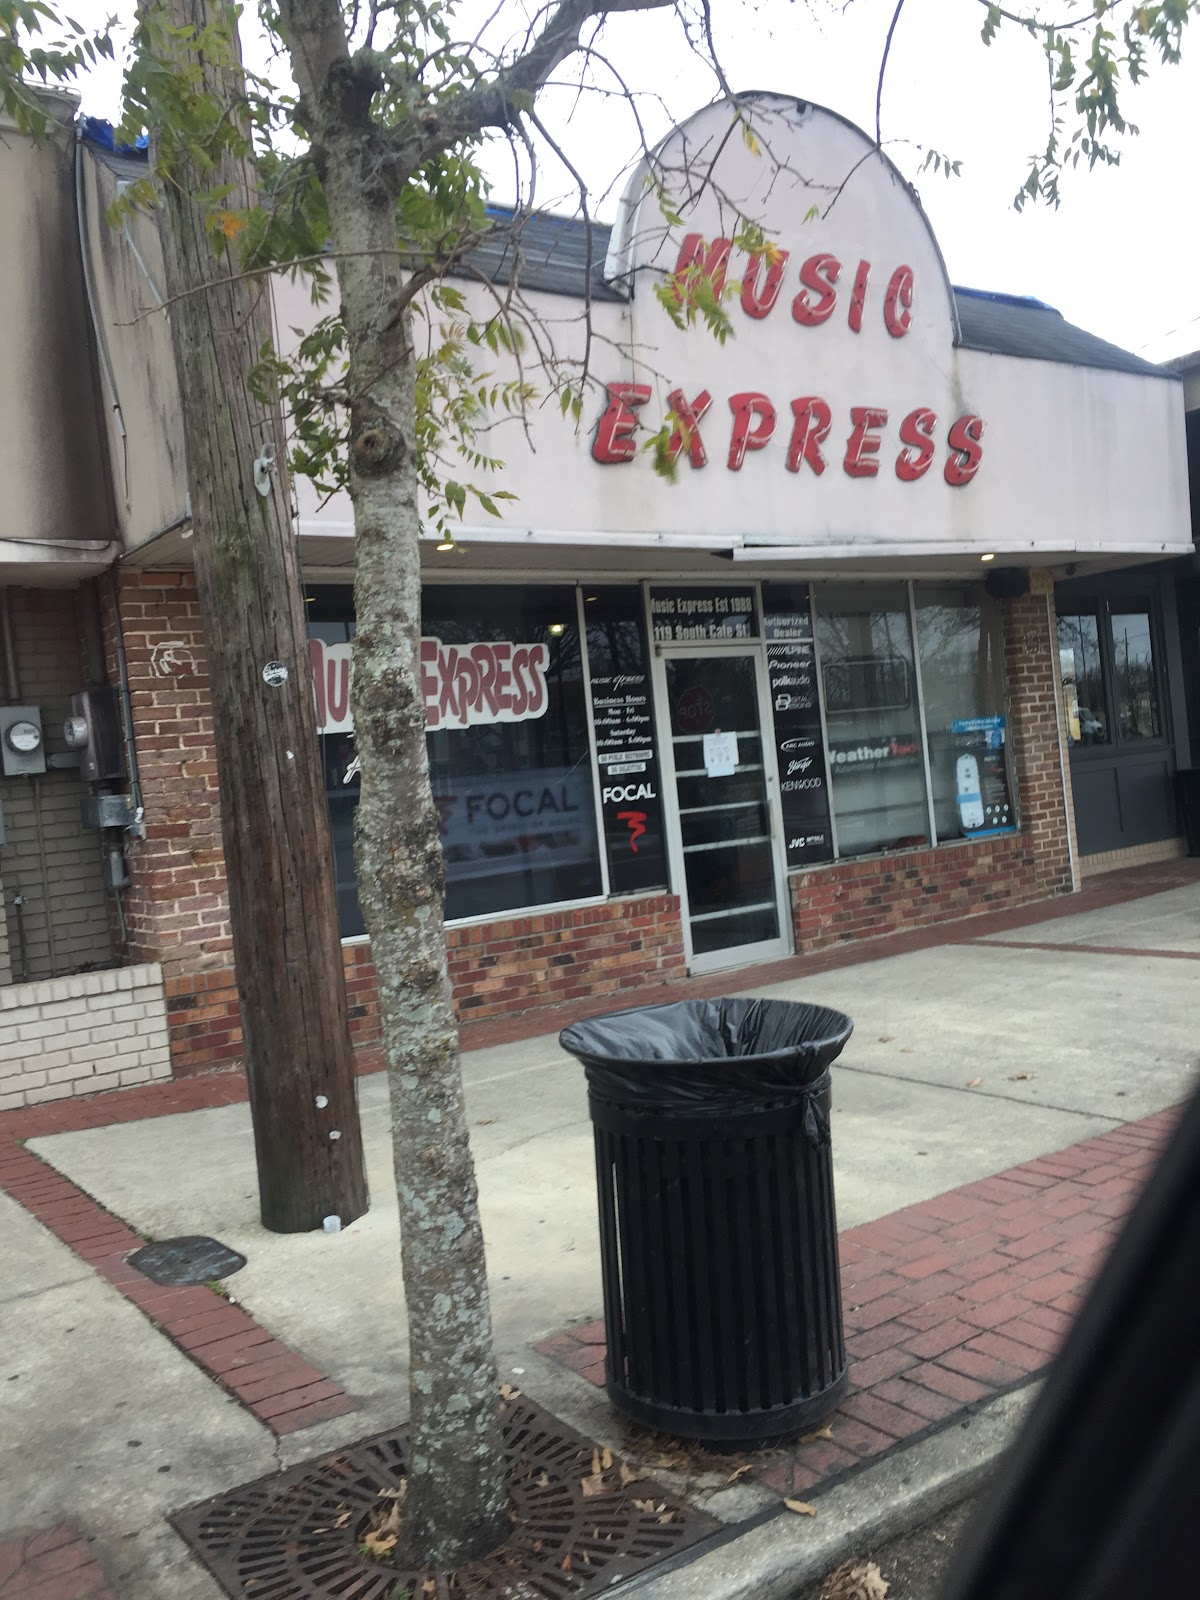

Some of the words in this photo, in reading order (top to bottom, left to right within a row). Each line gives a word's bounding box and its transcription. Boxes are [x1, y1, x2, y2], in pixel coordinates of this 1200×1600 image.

[673, 233, 915, 338] MUSIC
[591, 382, 987, 487] EXPRESS
[677, 598, 714, 615] Express
[715, 597, 729, 612] Est
[654, 626, 673, 641] 119
[675, 624, 706, 640] South
[774, 628, 803, 638] Dealer
[769, 659, 812, 670] Pioneer
[421, 638, 544, 726] EXPRESS
[603, 783, 656, 803] FOCAL
[781, 777, 821, 792] KENWOOD
[466, 785, 579, 824] FOCAL
[789, 837, 805, 848] JVC
